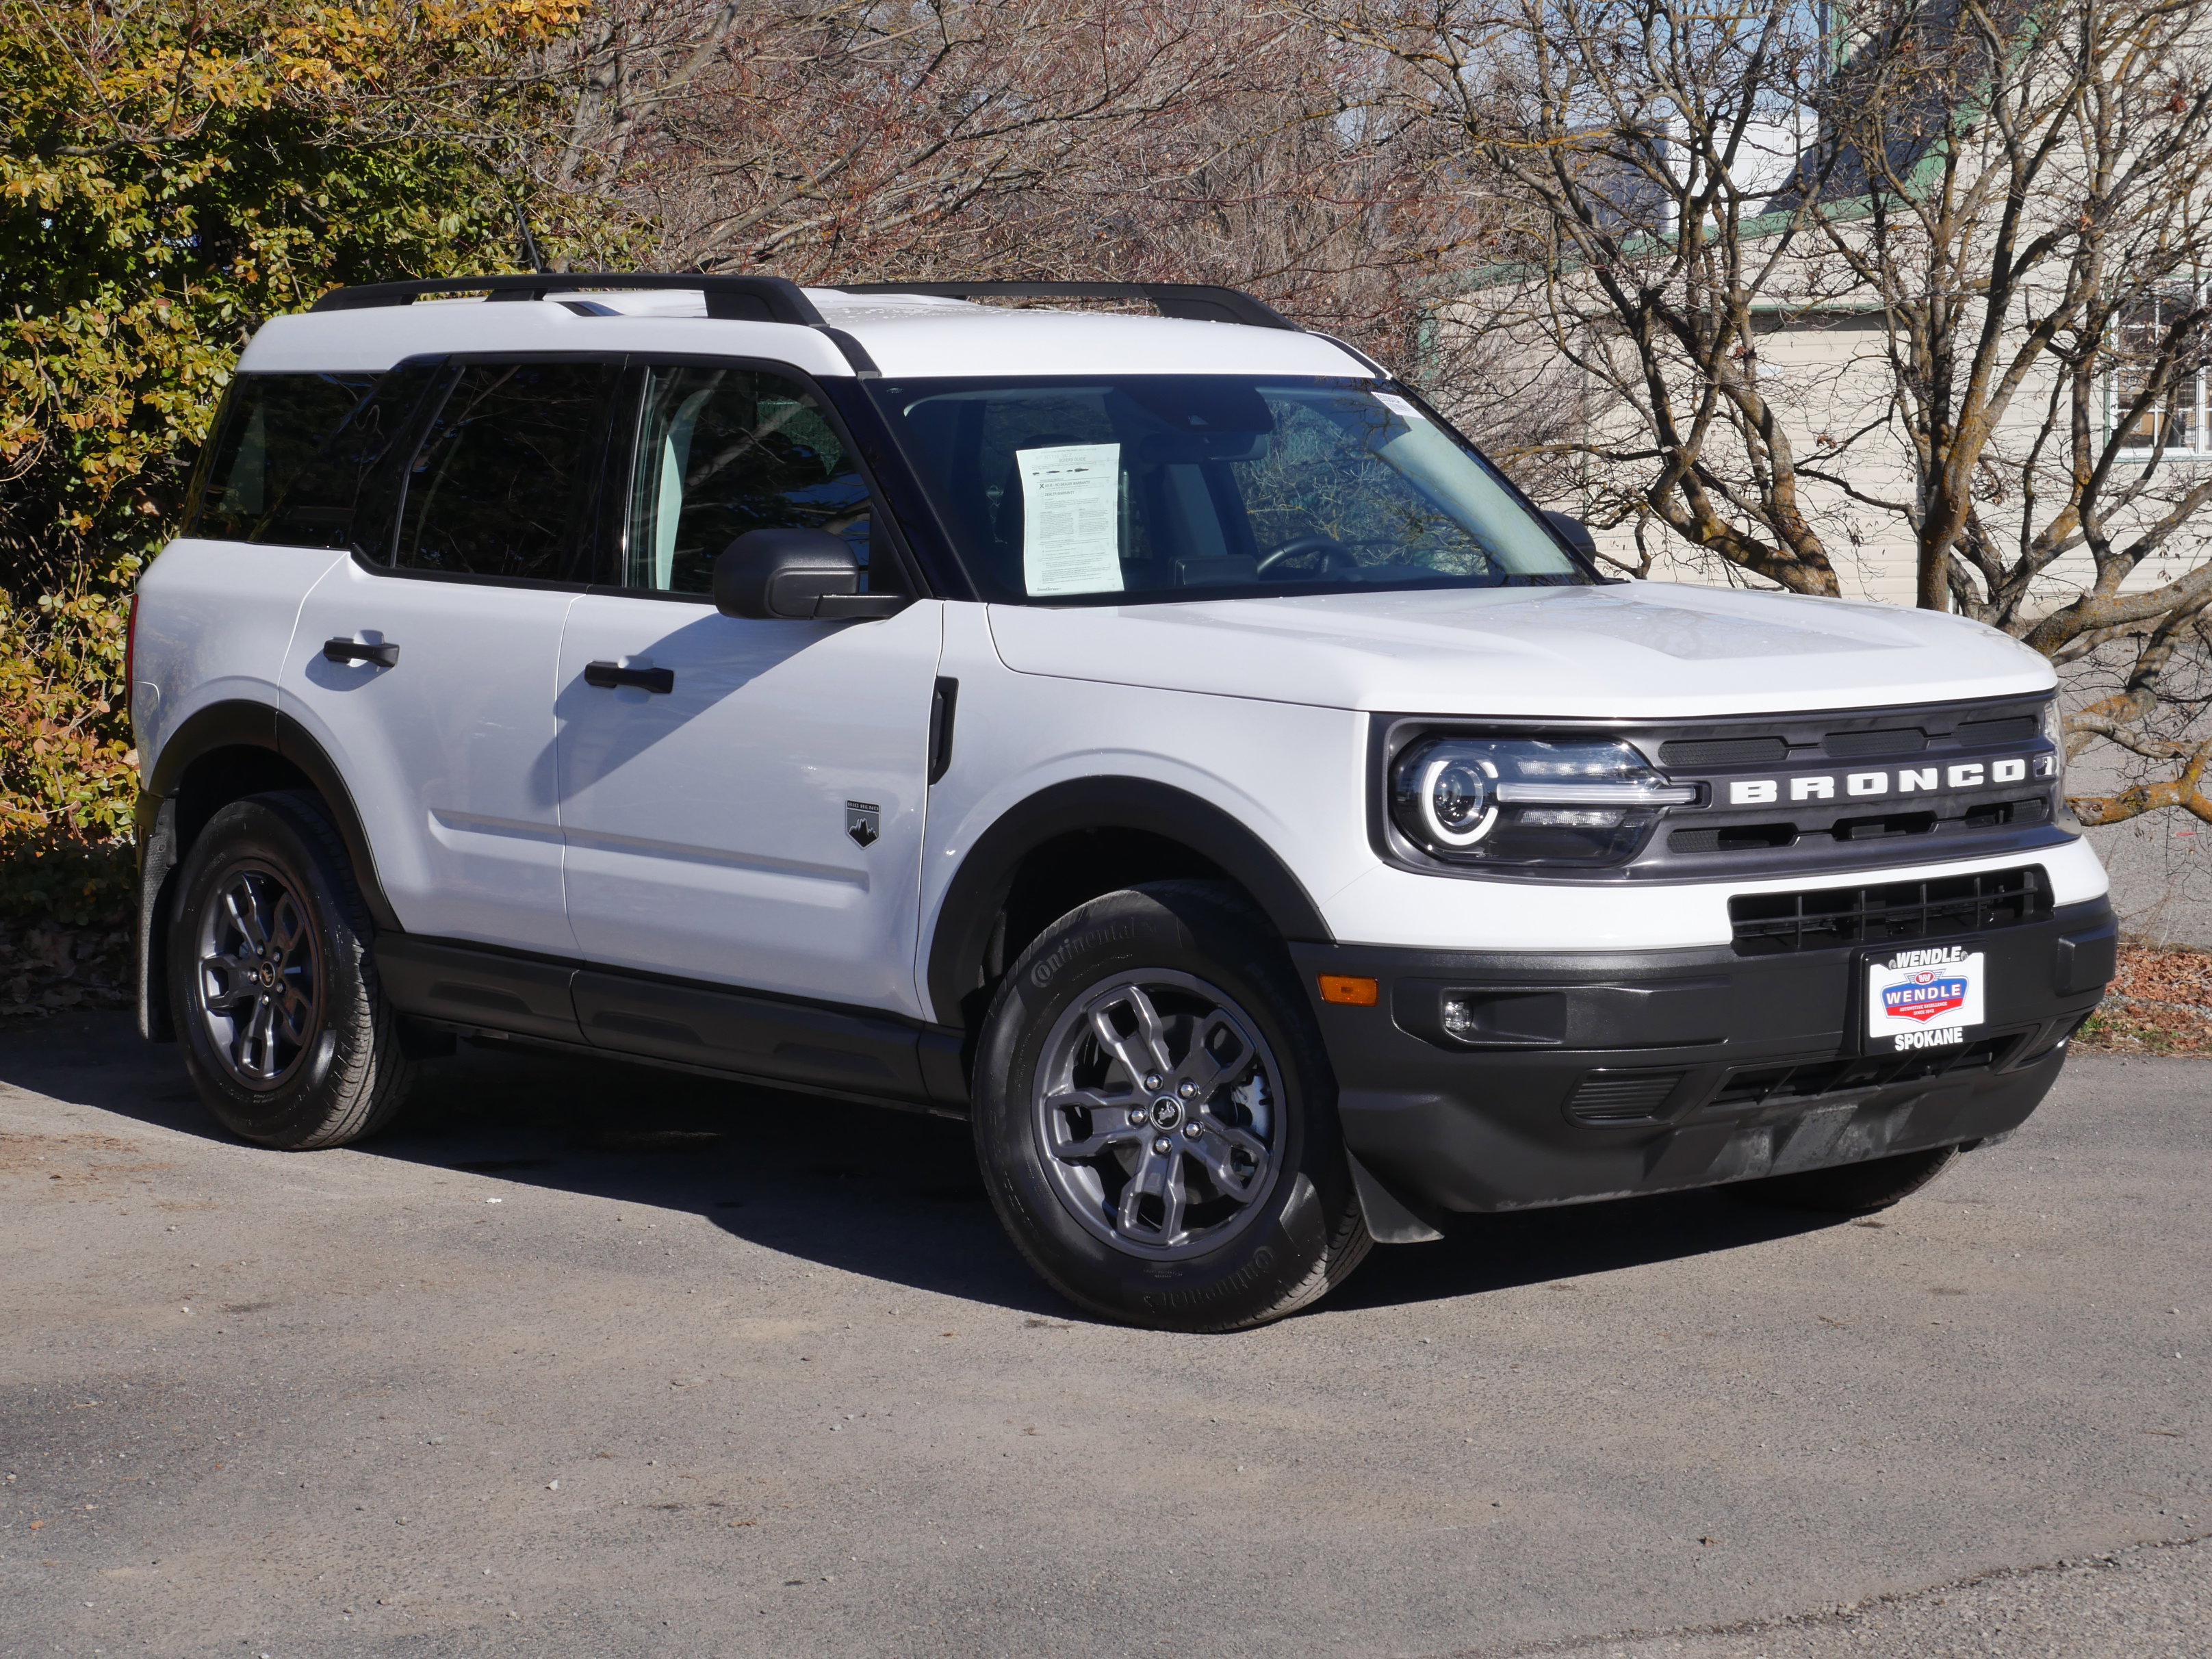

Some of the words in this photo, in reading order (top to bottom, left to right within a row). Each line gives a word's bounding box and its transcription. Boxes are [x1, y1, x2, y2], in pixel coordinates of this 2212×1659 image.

[1729, 758, 2026, 805] BRONCO
[1896, 946, 1962, 968] WENDLE
[1918, 973, 1931, 983] W
[1886, 983, 1961, 1005] WENDLE
[1899, 1004, 1924, 1012] AUTOMOTIVE
[1924, 1001, 1948, 1009] EXCELLENCE
[1895, 1027, 1963, 1051] SPOKANE
